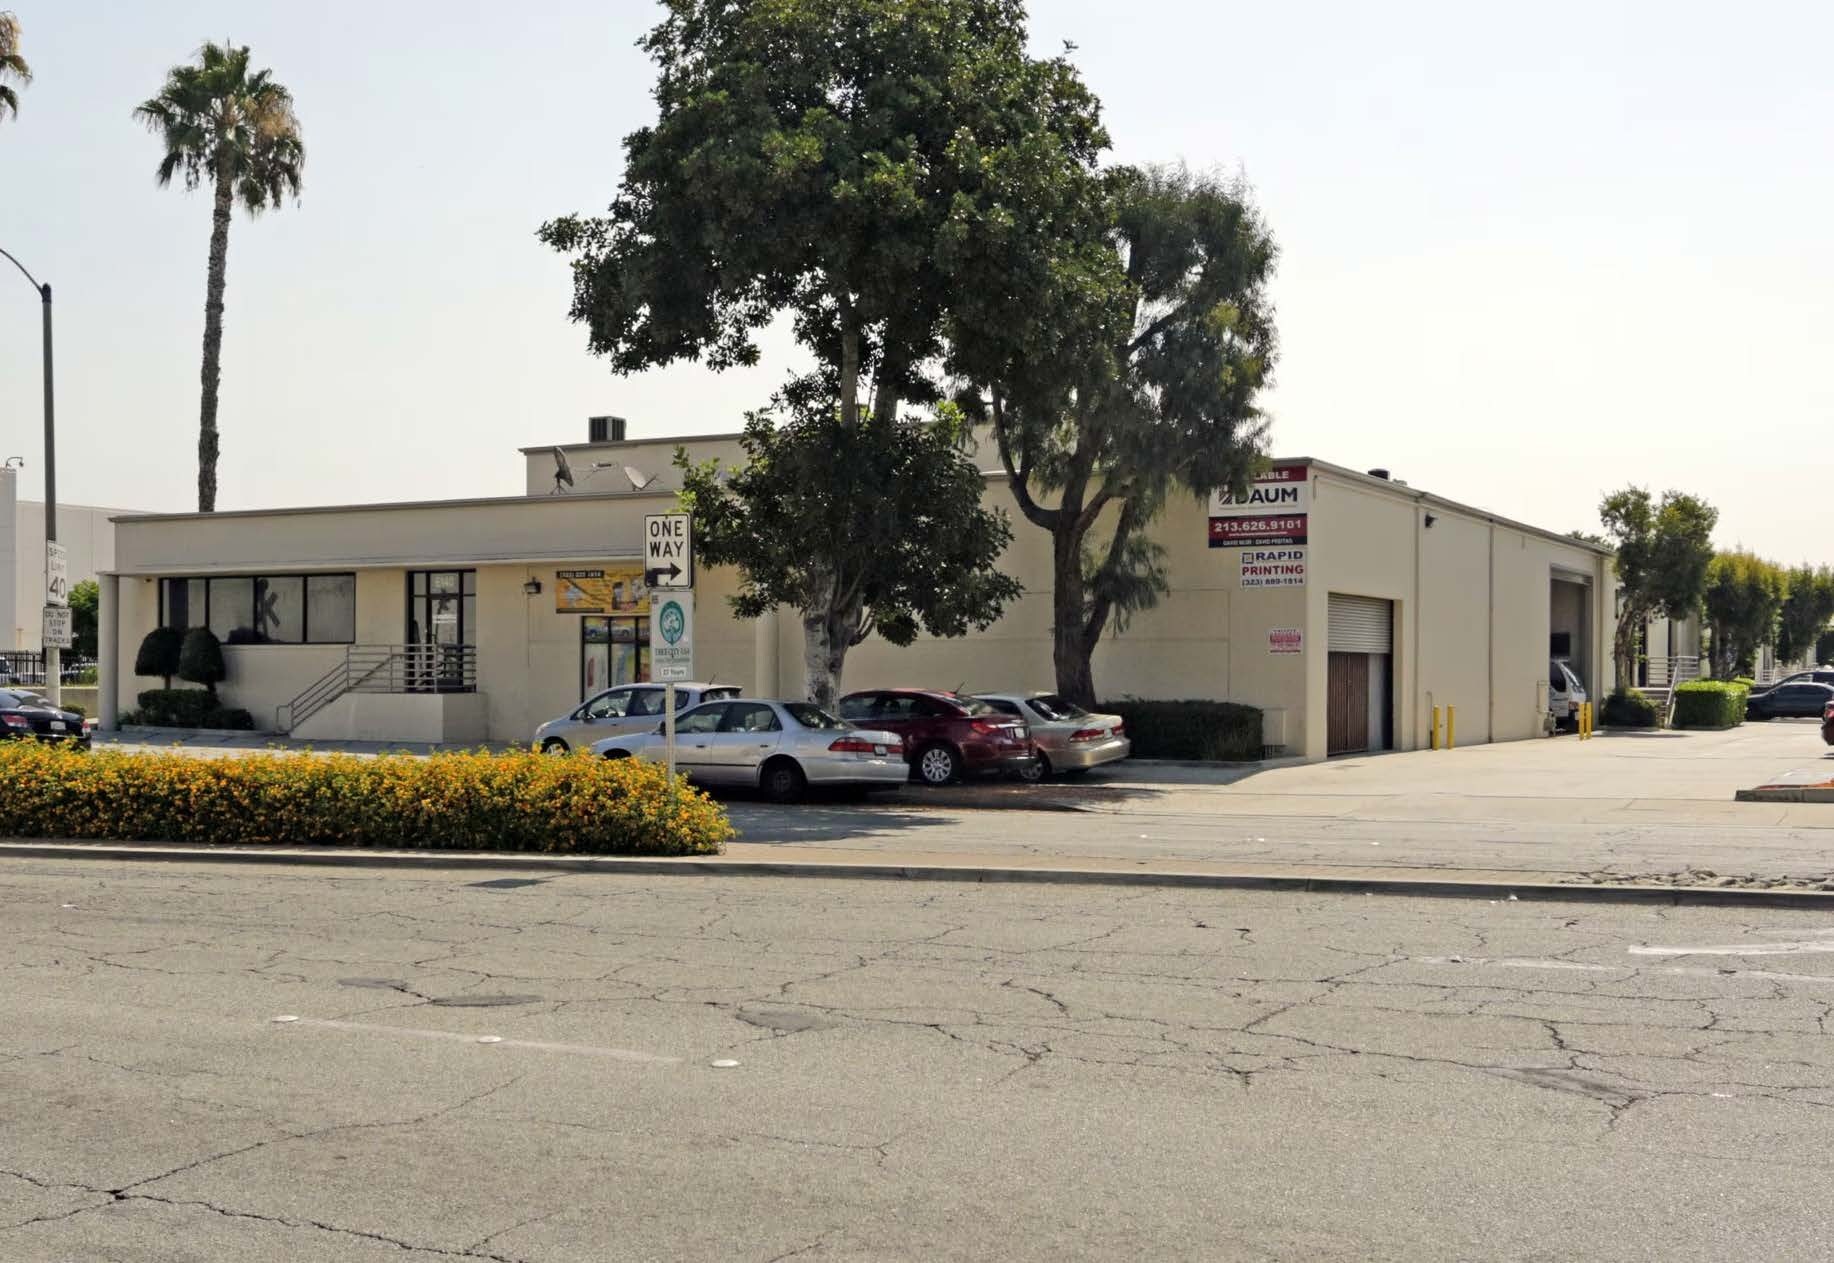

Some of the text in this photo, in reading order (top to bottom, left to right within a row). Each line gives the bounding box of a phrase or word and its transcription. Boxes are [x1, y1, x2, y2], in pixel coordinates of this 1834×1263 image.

[650, 520, 683, 538] ONE
[1215, 520, 1301, 532] 213.626.9101
[650, 541, 684, 558] WAY
[1255, 551, 1303, 560] RAPID
[1242, 565, 1304, 576] PRINTING
[49, 576, 66, 599] 40
[49, 619, 65, 627] STOP
